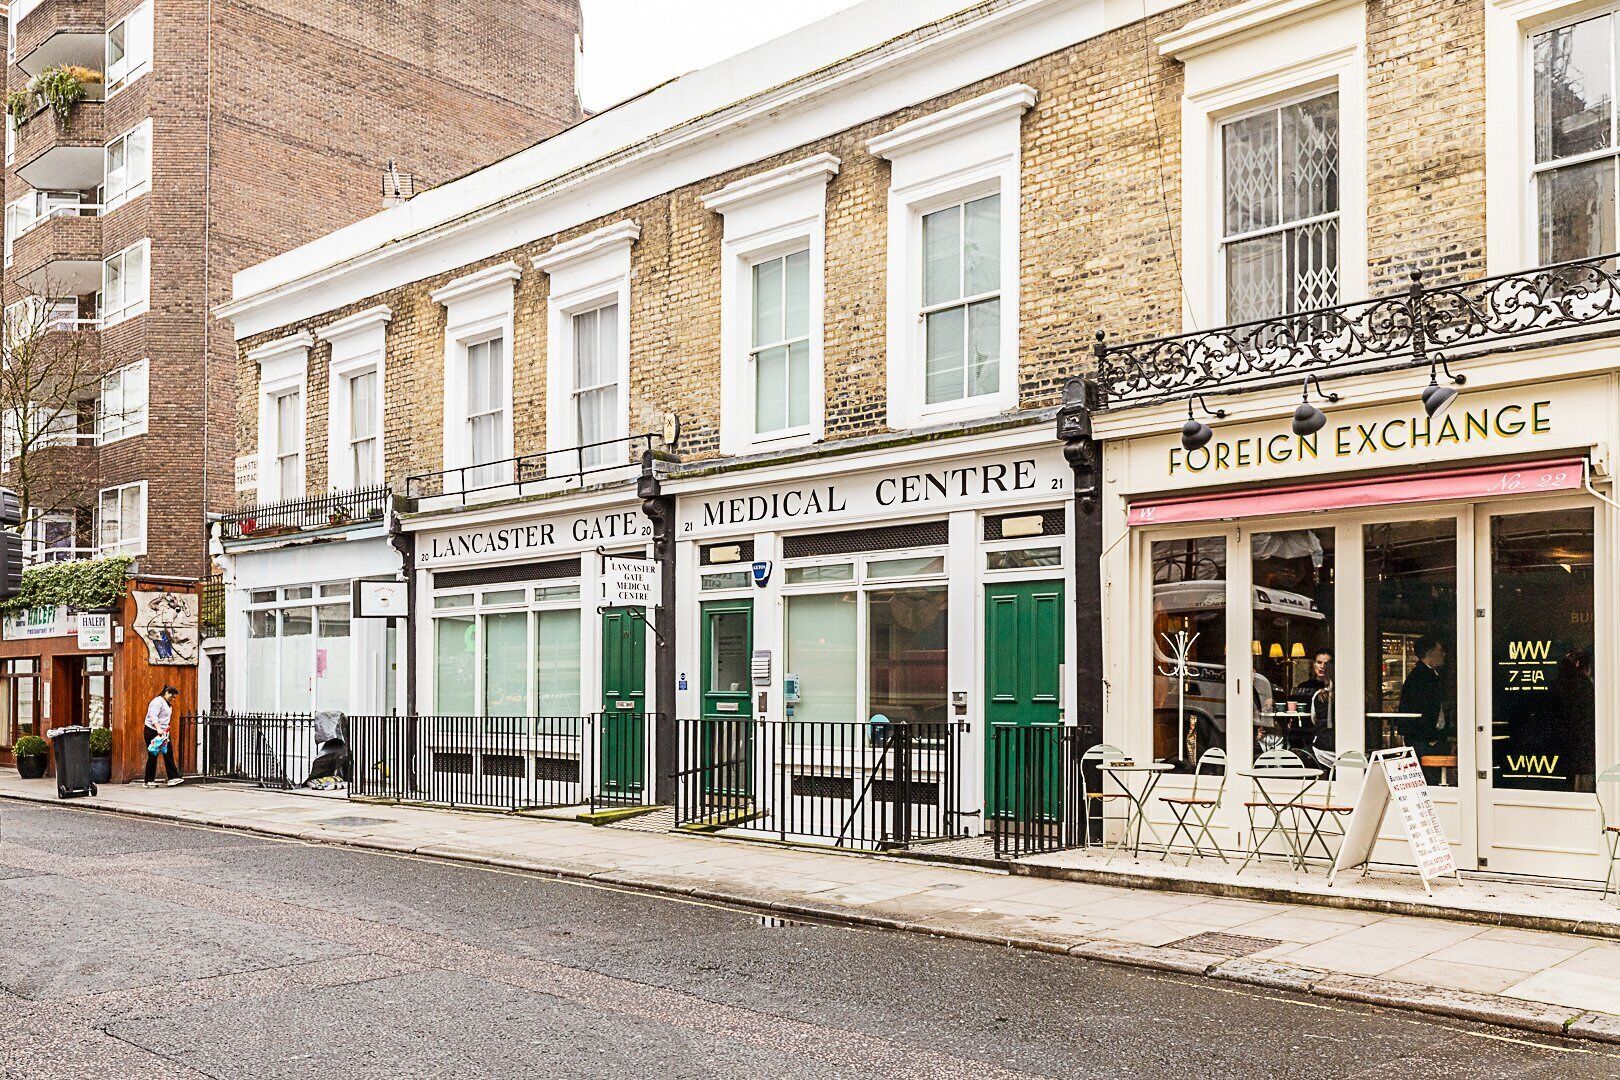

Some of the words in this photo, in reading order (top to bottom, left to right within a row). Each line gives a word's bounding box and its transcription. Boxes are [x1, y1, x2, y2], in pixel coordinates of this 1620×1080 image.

[1169, 432, 1318, 475] FOREIGN
[1335, 401, 1551, 457] EXCHANGE
[1534, 472, 1567, 488] 22
[703, 486, 847, 526] MEDICAL
[875, 459, 1036, 506] CENTRE
[1051, 478, 1063, 490] 21
[684, 522, 693, 532] 21
[421, 553, 430, 561] 20
[433, 523, 555, 558] LANCASTER
[572, 512, 637, 542] GATE
[641, 526, 651, 536] 20
[612, 563, 656, 573] LANCASTER
[617, 582, 651, 591] MEDICAL
[618, 592, 649, 600] CENTRE
[82, 617, 105, 627] HALEPI
[1400, 779, 1426, 790] COMMISSION
